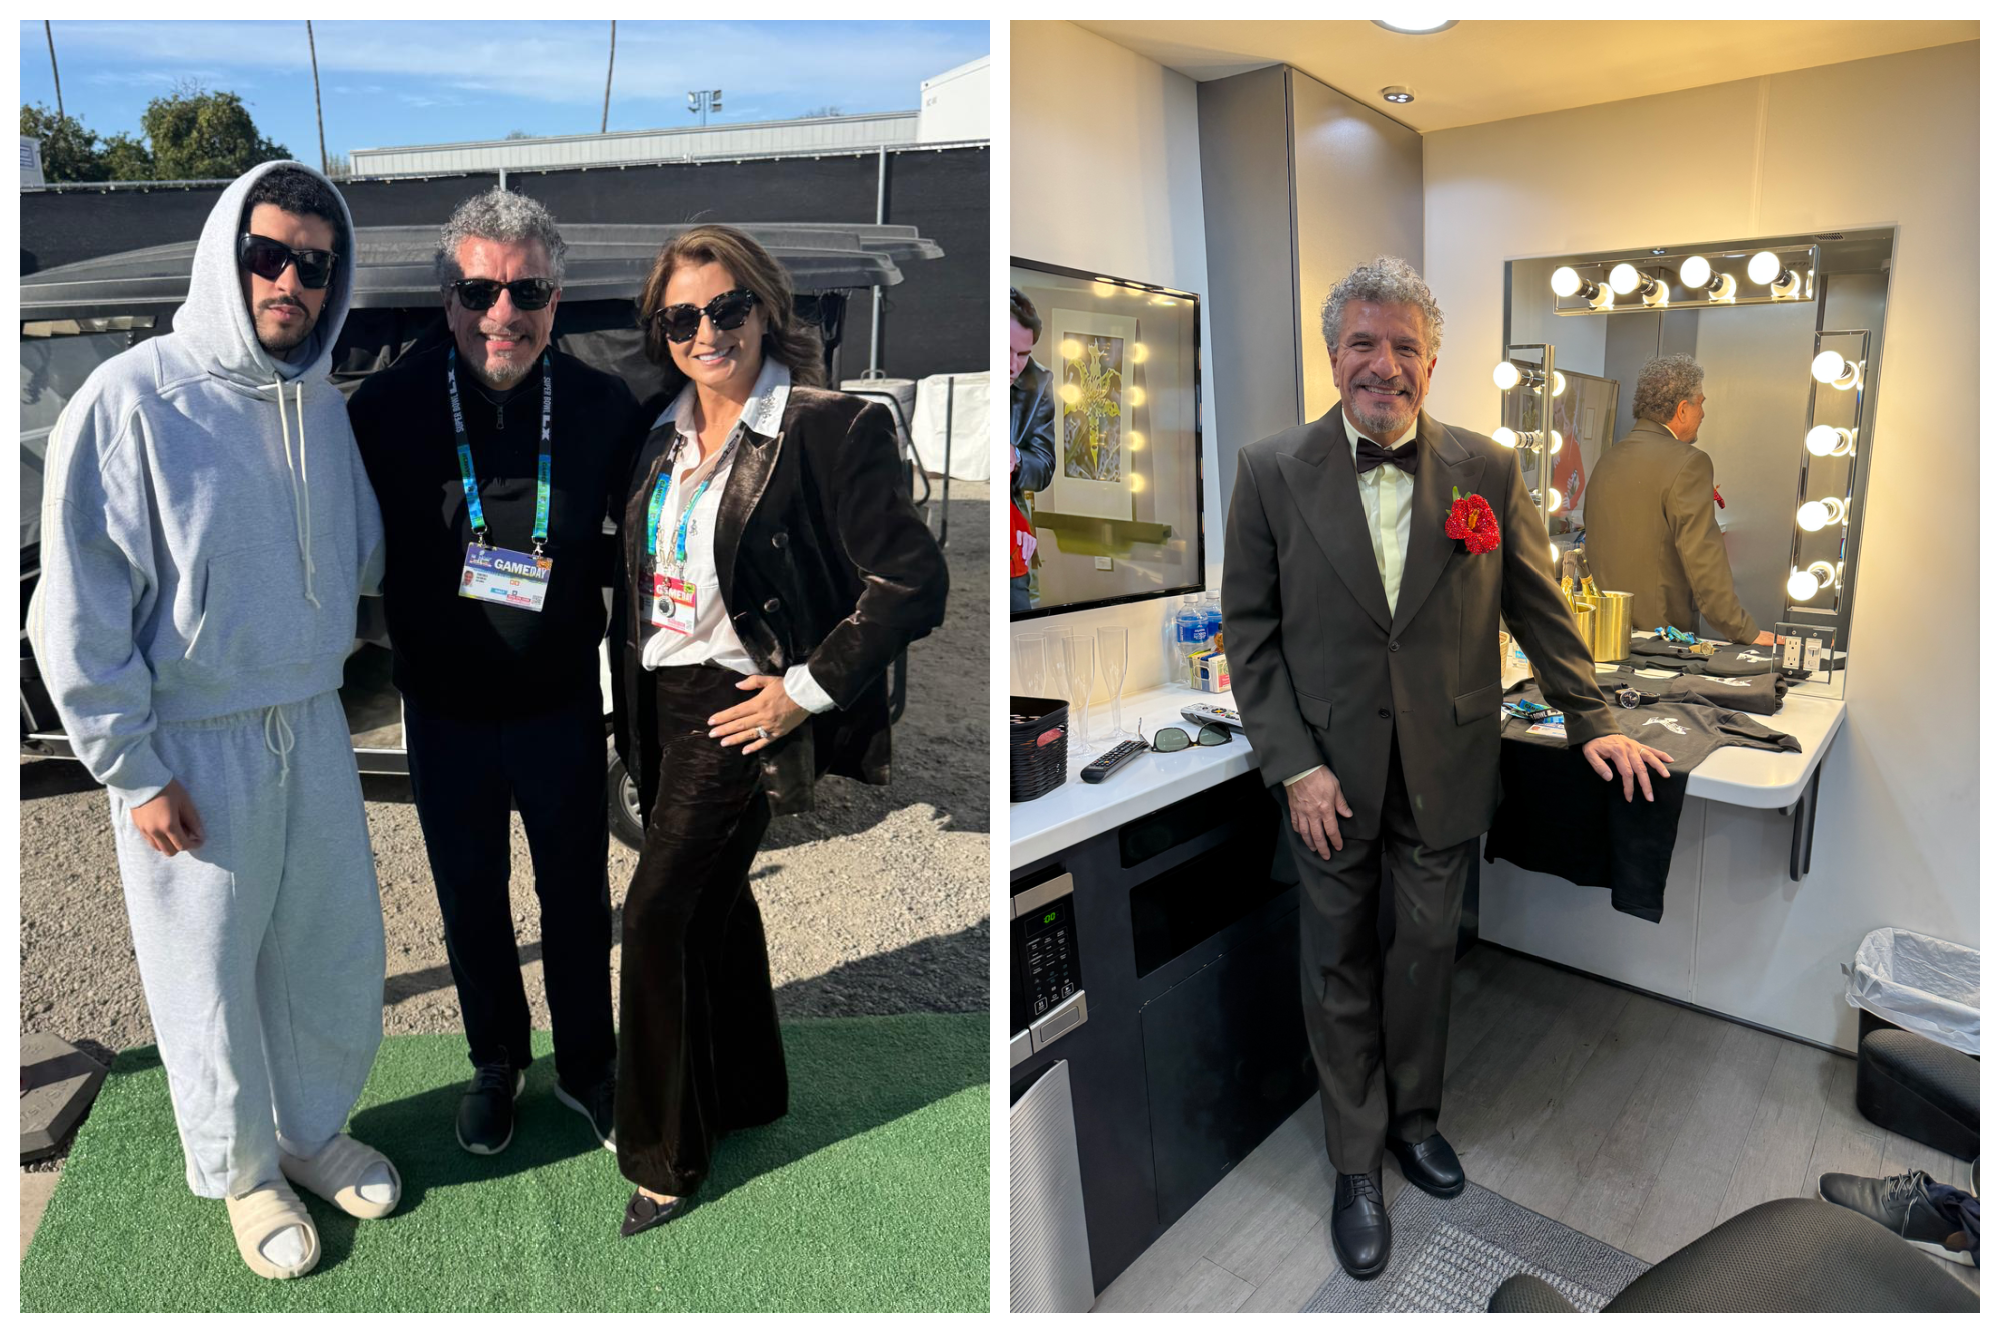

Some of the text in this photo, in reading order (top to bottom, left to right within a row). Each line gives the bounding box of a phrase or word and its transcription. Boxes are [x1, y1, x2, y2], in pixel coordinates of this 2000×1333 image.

[448, 368, 464, 433] SUPER BOWL LX
[542, 376, 551, 440] SUPER BOWL LX
[494, 558, 547, 580] GAMEDAY
